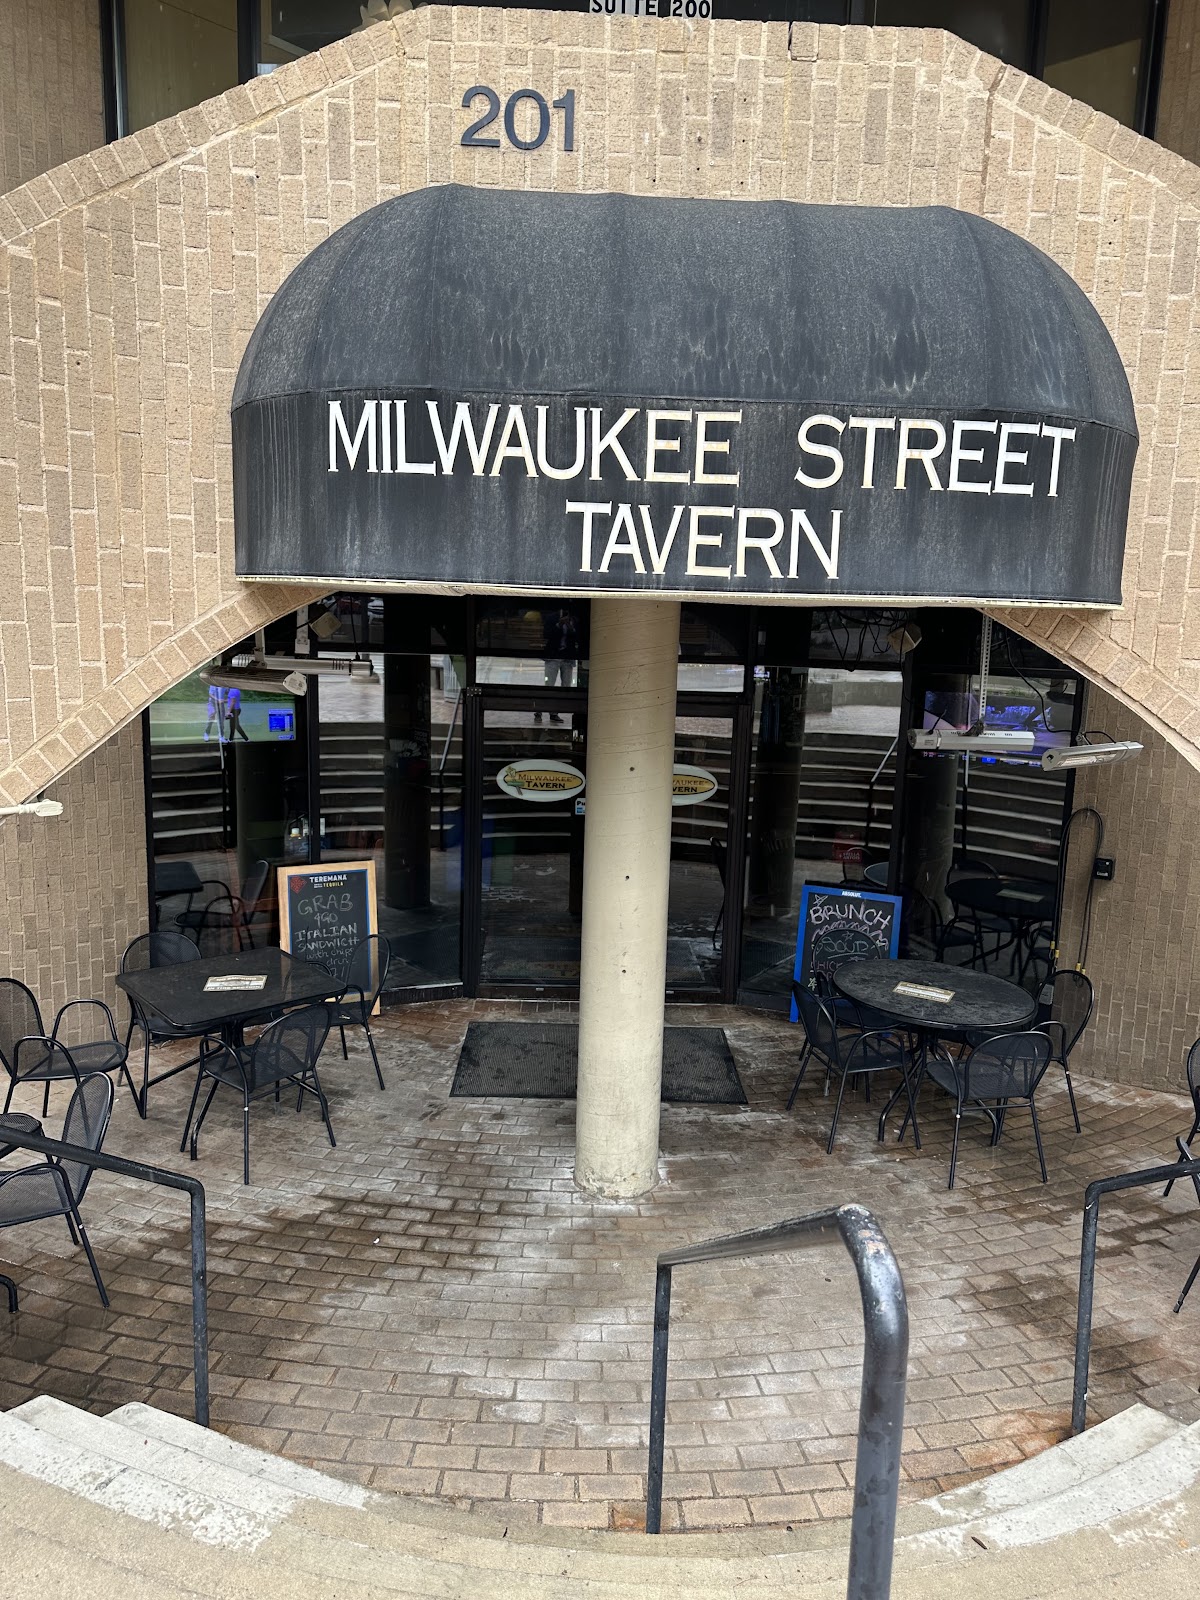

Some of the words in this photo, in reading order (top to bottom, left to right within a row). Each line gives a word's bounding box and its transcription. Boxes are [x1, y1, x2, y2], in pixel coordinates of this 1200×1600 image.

[673, 0, 711, 18] 200
[461, 85, 576, 151] 201
[328, 400, 742, 487] MILWAUKEE
[794, 414, 1076, 497] STREET
[565, 500, 843, 580] TAVERN
[518, 774, 572, 782] MILWAUKEE
[309, 874, 347, 883] TEREMANA
[298, 893, 353, 915] GRAB
[810, 902, 891, 930] BRUNCH
[294, 922, 358, 943] ITALIAN
[297, 936, 360, 953] SANDWICH
[821, 936, 869, 953] SOUP
